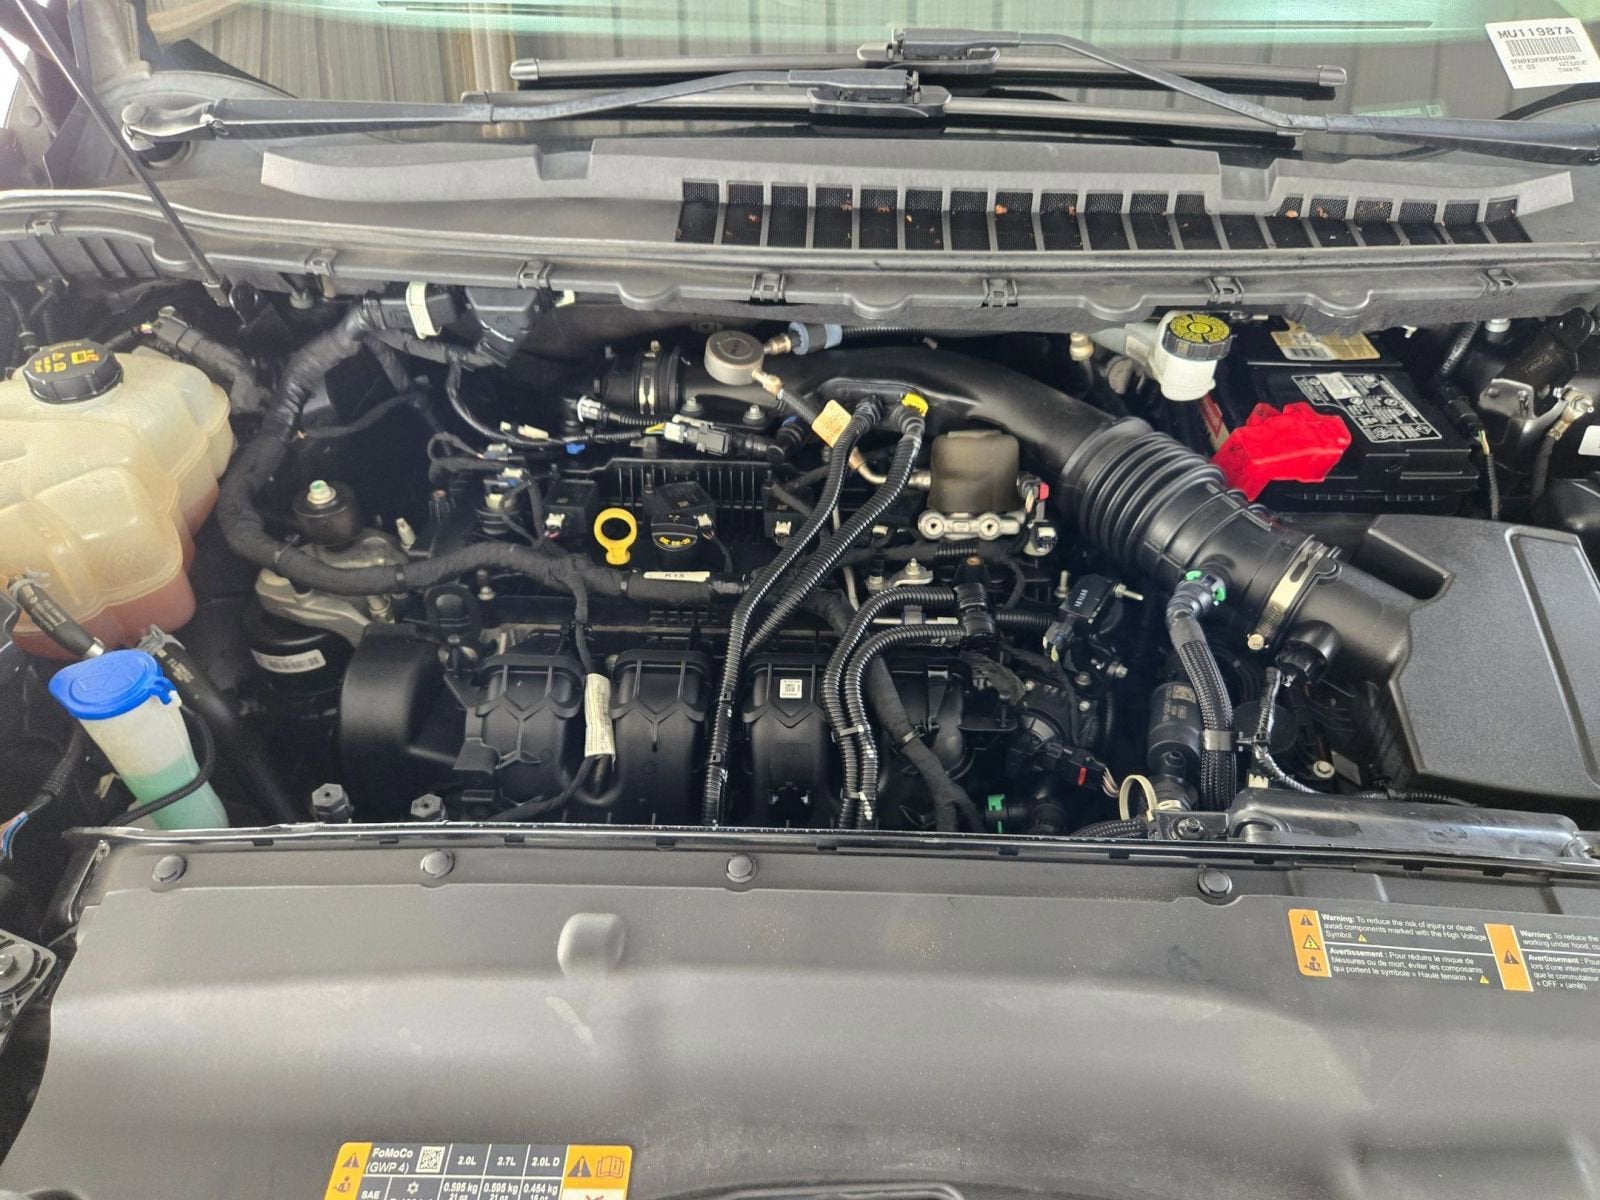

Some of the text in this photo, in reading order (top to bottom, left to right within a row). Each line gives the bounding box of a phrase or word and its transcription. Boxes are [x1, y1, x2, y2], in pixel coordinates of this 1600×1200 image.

[1497, 26, 1575, 39] MU11987A
[1321, 913, 1355, 924] Warning:
[1356, 915, 1365, 923] To
[1367, 917, 1391, 925] reduce
[1391, 918, 1403, 927] the
[1404, 920, 1418, 928] risk
[1418, 920, 1426, 928] of
[1426, 921, 1446, 931] injury
[1344, 924, 1387, 933] components
[1388, 926, 1414, 935] marked
[1415, 928, 1430, 936] with
[1430, 929, 1442, 937] the
[1443, 931, 1460, 940] High
[1460, 932, 1487, 942] Voltage
[1563, 933, 1586, 941] reduce
[1523, 939, 1550, 947] working
[1550, 940, 1569, 948] under
[1330, 947, 1384, 958] Avertissement
[1389, 951, 1406, 959] Pour
[1441, 956, 1464, 964] risque
[1464, 957, 1474, 965] de
[1529, 954, 1580, 964] Avertissement
[1331, 955, 1366, 965] blessures
[1428, 962, 1440, 970] les
[1441, 965, 1484, 974] composants
[1531, 962, 1544, 970] lors
[1333, 965, 1345, 973] qui
[1346, 966, 1371, 974] portent
[1380, 968, 1410, 977] symbole
[1440, 972, 1466, 981] tension
[1533, 972, 1546, 980] que
[1547, 971, 1554, 979] le
[1541, 980, 1557, 988] OFF
[372, 1147, 414, 1158] FoMoCo
[457, 1155, 477, 1166] 2.0L
[497, 1156, 517, 1166] 2.7L
[531, 1156, 560, 1167] 2.0L D
[365, 1161, 410, 1175] (GWP 4)
[443, 1182, 479, 1195] 0.595 kg
[483, 1182, 519, 1195] 0.595 kg
[523, 1183, 559, 1196] 0.454 kg
[361, 1190, 381, 1200] SAE
